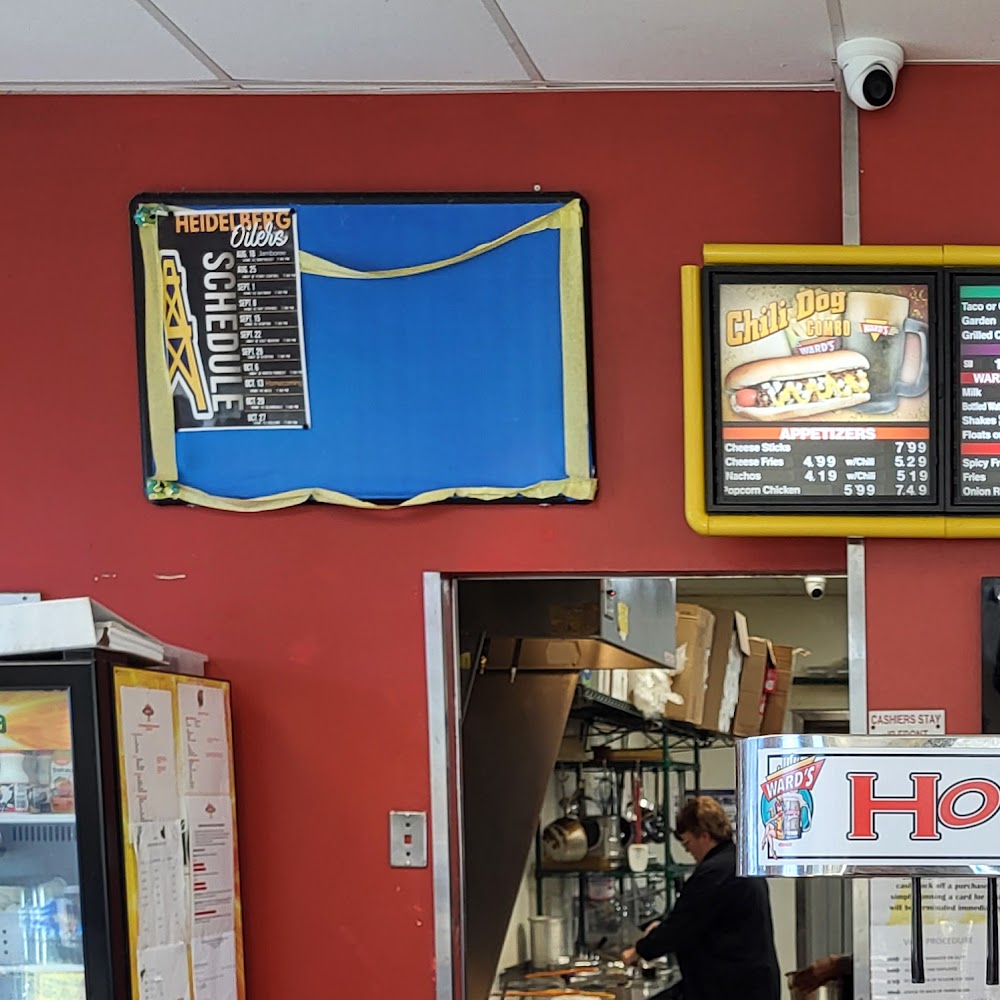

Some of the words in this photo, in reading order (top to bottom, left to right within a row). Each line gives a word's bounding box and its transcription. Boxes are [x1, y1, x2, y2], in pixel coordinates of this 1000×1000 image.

[175, 212, 291, 233] HEIDELBERG
[230, 224, 288, 248] Oilers
[962, 302, 984, 311] Taco
[986, 302, 997, 311] or
[726, 300, 788, 346] Chili
[796, 287, 847, 321] Dog
[961, 316, 997, 326] Garden
[202, 252, 244, 411] SCHEDULE
[806, 319, 851, 337] COMBO
[961, 330, 993, 340] Grilled
[799, 340, 835, 354] WARD'S
[962, 388, 982, 398] Milk
[962, 416, 997, 426] Shakes
[779, 428, 876, 440] APPETIZERS
[962, 430, 991, 440] Floats
[724, 443, 760, 452] Cheese
[762, 443, 792, 452] Sticks
[724, 457, 760, 466] Cheese
[761, 457, 784, 466] Fries
[962, 458, 988, 469] Spicy
[725, 471, 762, 481] Nachos
[962, 472, 986, 482] Fries
[962, 487, 991, 497] Onion
[871, 715, 916, 724] CASHIERS
[918, 715, 941, 724] STAY
[766, 765, 815, 798] WARD'S
